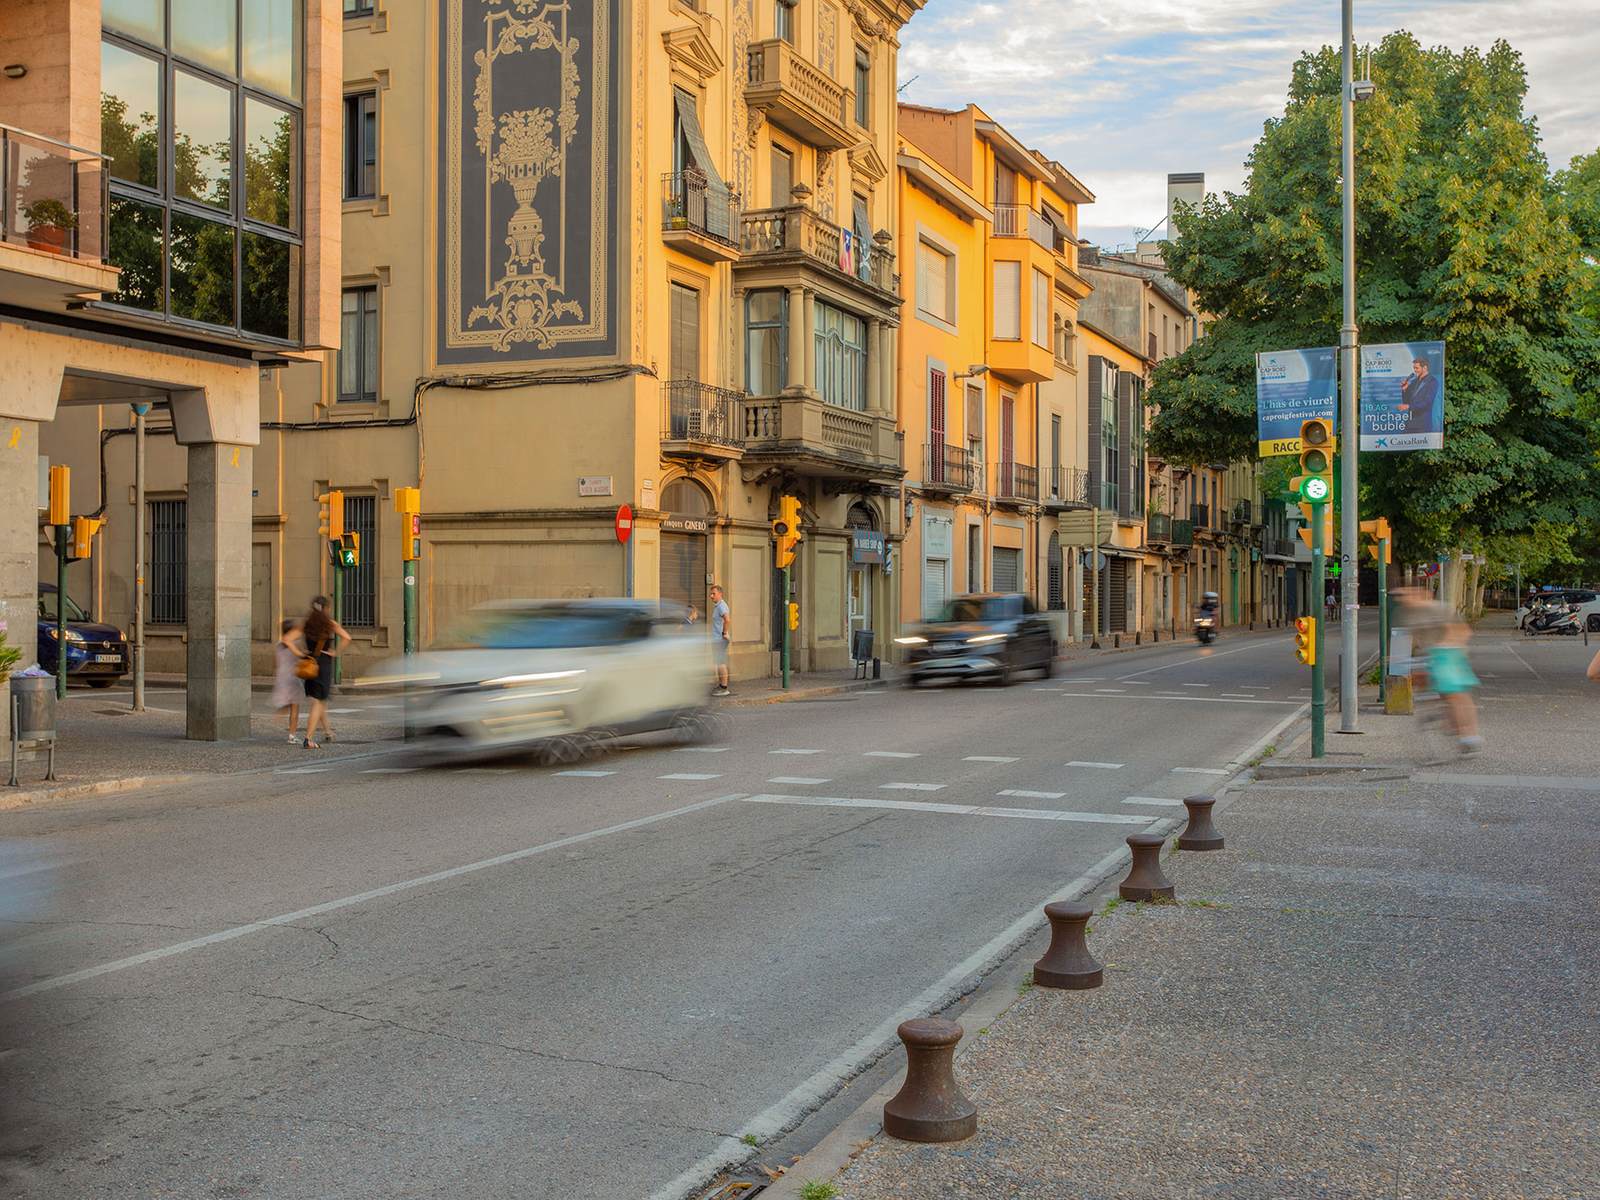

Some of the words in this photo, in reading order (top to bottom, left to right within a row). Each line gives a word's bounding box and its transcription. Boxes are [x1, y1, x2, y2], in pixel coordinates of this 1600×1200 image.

[1288, 398, 1300, 407] de
[1303, 396, 1333, 406] viure!
[1262, 410, 1333, 422] caproigfestival.com
[1365, 410, 1412, 422] michael
[1372, 421, 1406, 431] bublé
[1273, 441, 1300, 453] RACC
